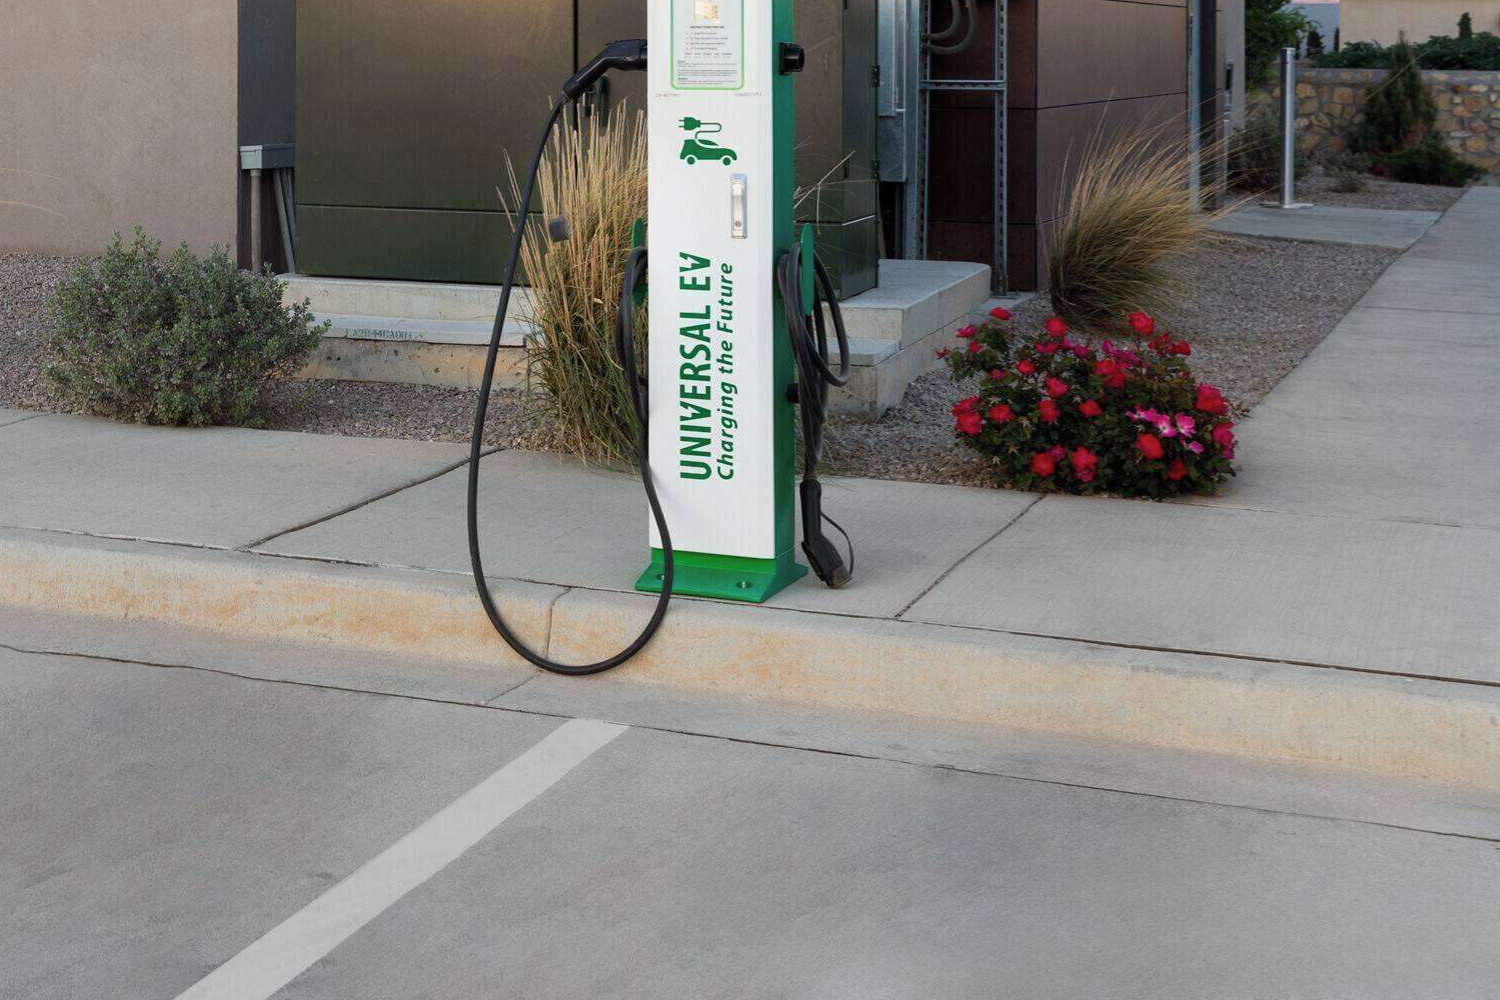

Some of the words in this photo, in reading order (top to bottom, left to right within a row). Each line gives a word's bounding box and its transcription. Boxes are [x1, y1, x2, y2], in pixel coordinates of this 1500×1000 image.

[679, 251, 711, 291] EV
[716, 262, 733, 334] Future
[679, 304, 712, 480] UNIVERSAL
[716, 340, 733, 374] the
[716, 381, 738, 480] Charging
